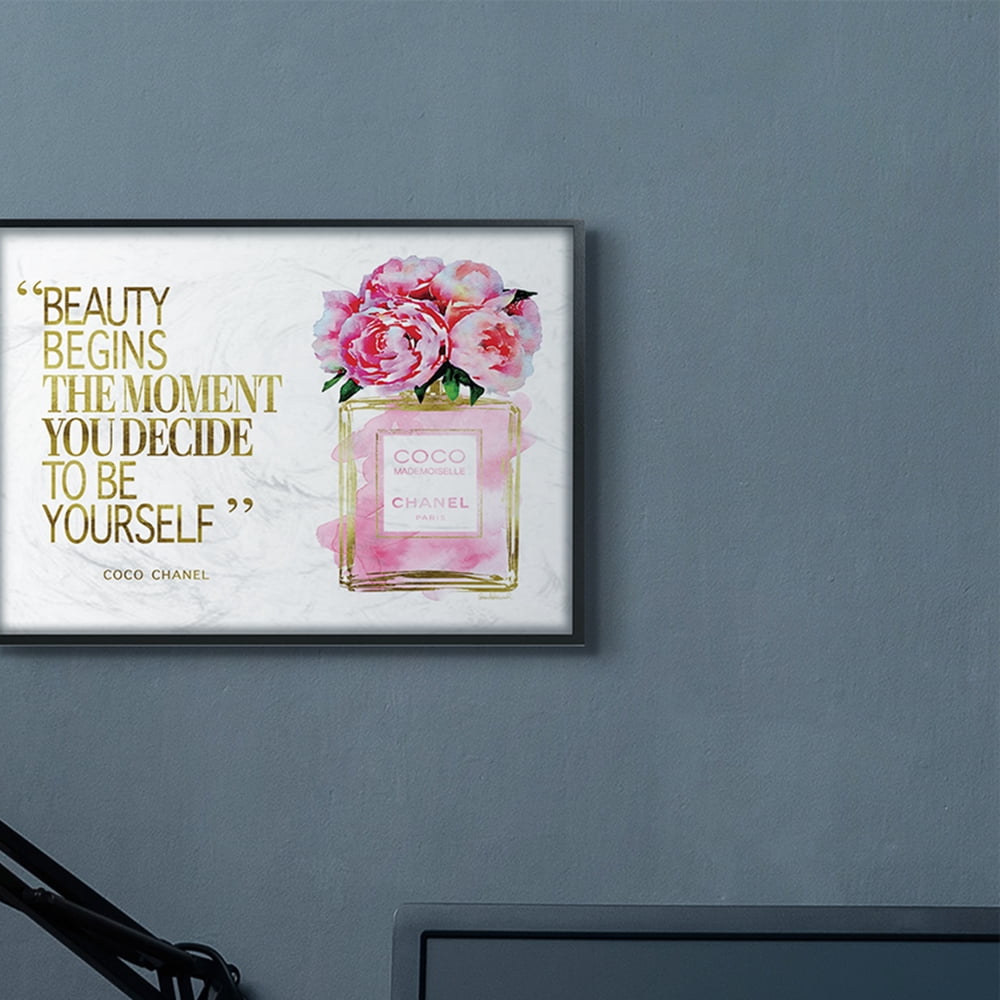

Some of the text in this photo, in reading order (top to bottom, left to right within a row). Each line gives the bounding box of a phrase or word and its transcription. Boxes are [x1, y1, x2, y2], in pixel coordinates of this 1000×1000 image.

[43, 329, 167, 370] BEGINS
[42, 374, 283, 414] THE MOMENT
[41, 417, 254, 458] YOU DECIDE
[393, 449, 466, 464] COCO
[42, 460, 137, 501] TO BE
[393, 467, 465, 475] MADEMOISELLE
[391, 497, 469, 509] CHANEL
[42, 503, 215, 545] YOURSELF
[103, 569, 210, 581] COCO CHANEL
